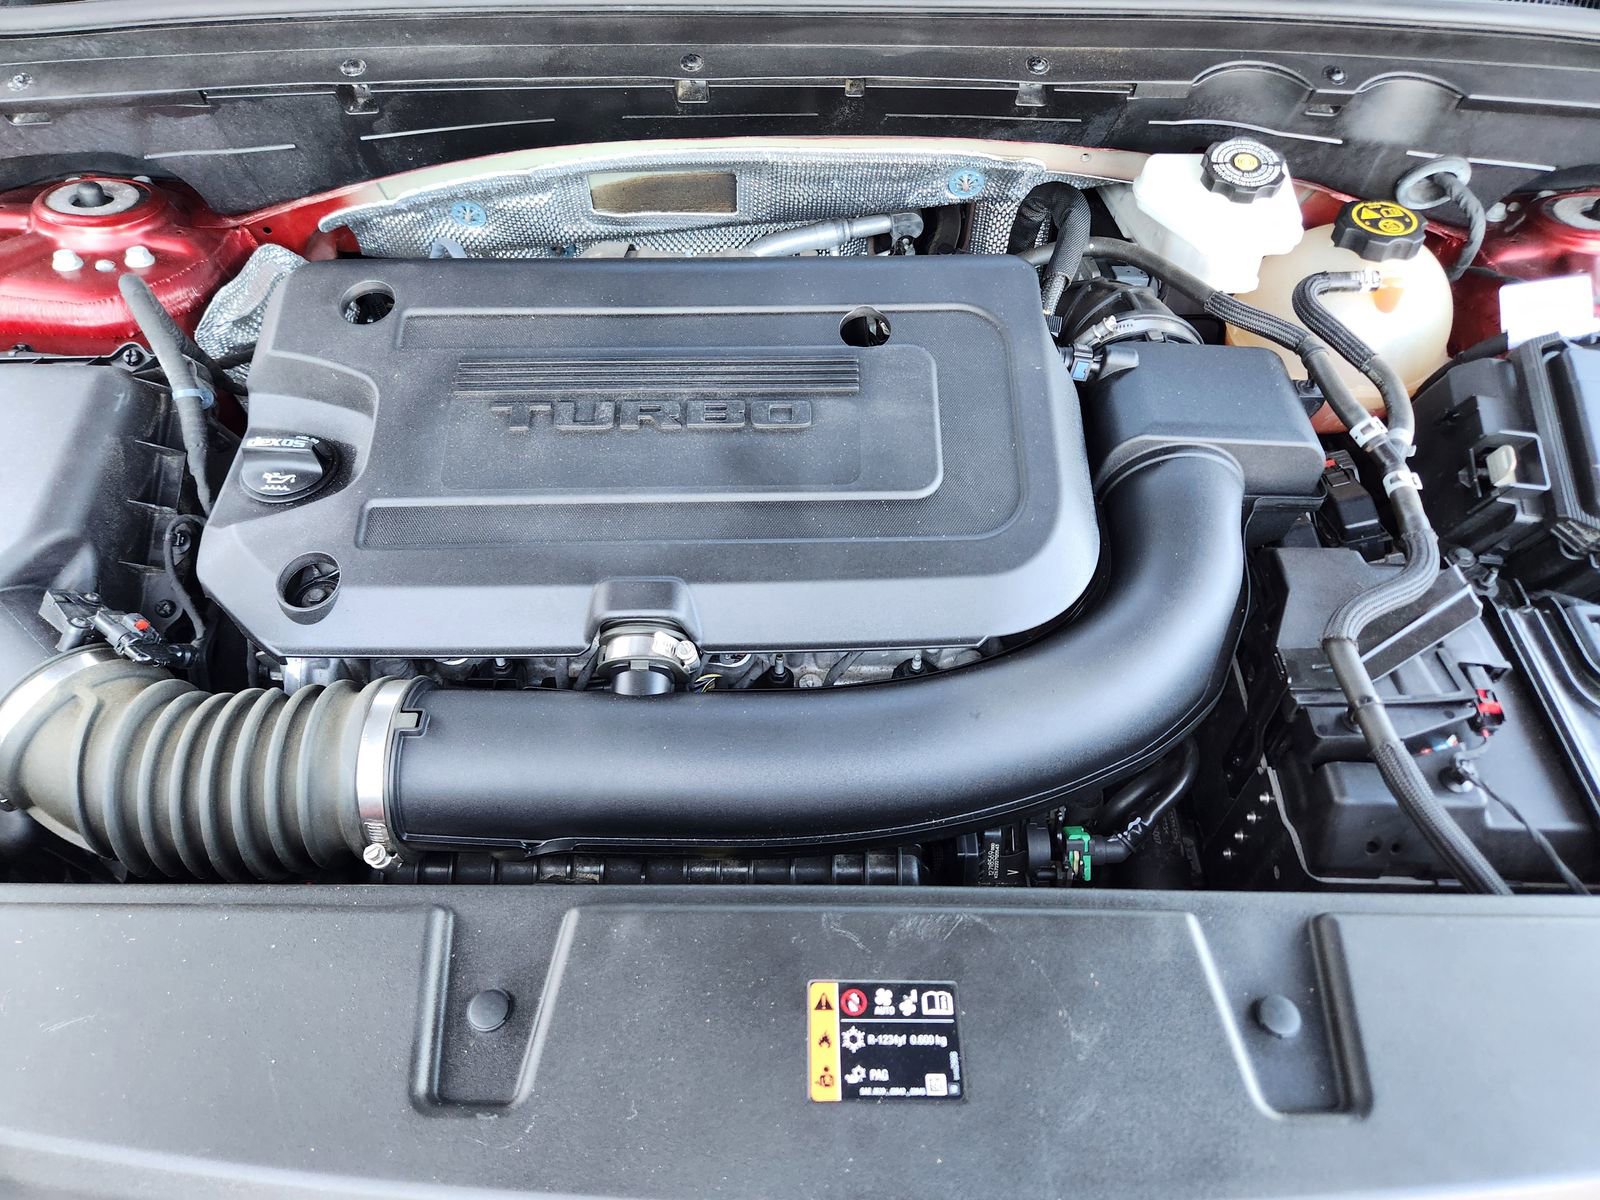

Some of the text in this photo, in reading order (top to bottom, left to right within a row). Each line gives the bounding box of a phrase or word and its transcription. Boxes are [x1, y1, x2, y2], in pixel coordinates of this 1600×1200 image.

[490, 399, 813, 432] TURBO
[246, 436, 308, 448] dexos
[873, 1005, 896, 1016] AUTO
[867, 1033, 907, 1048] R-1234yf
[935, 1033, 948, 1048] kg
[869, 1068, 890, 1082] PAG
